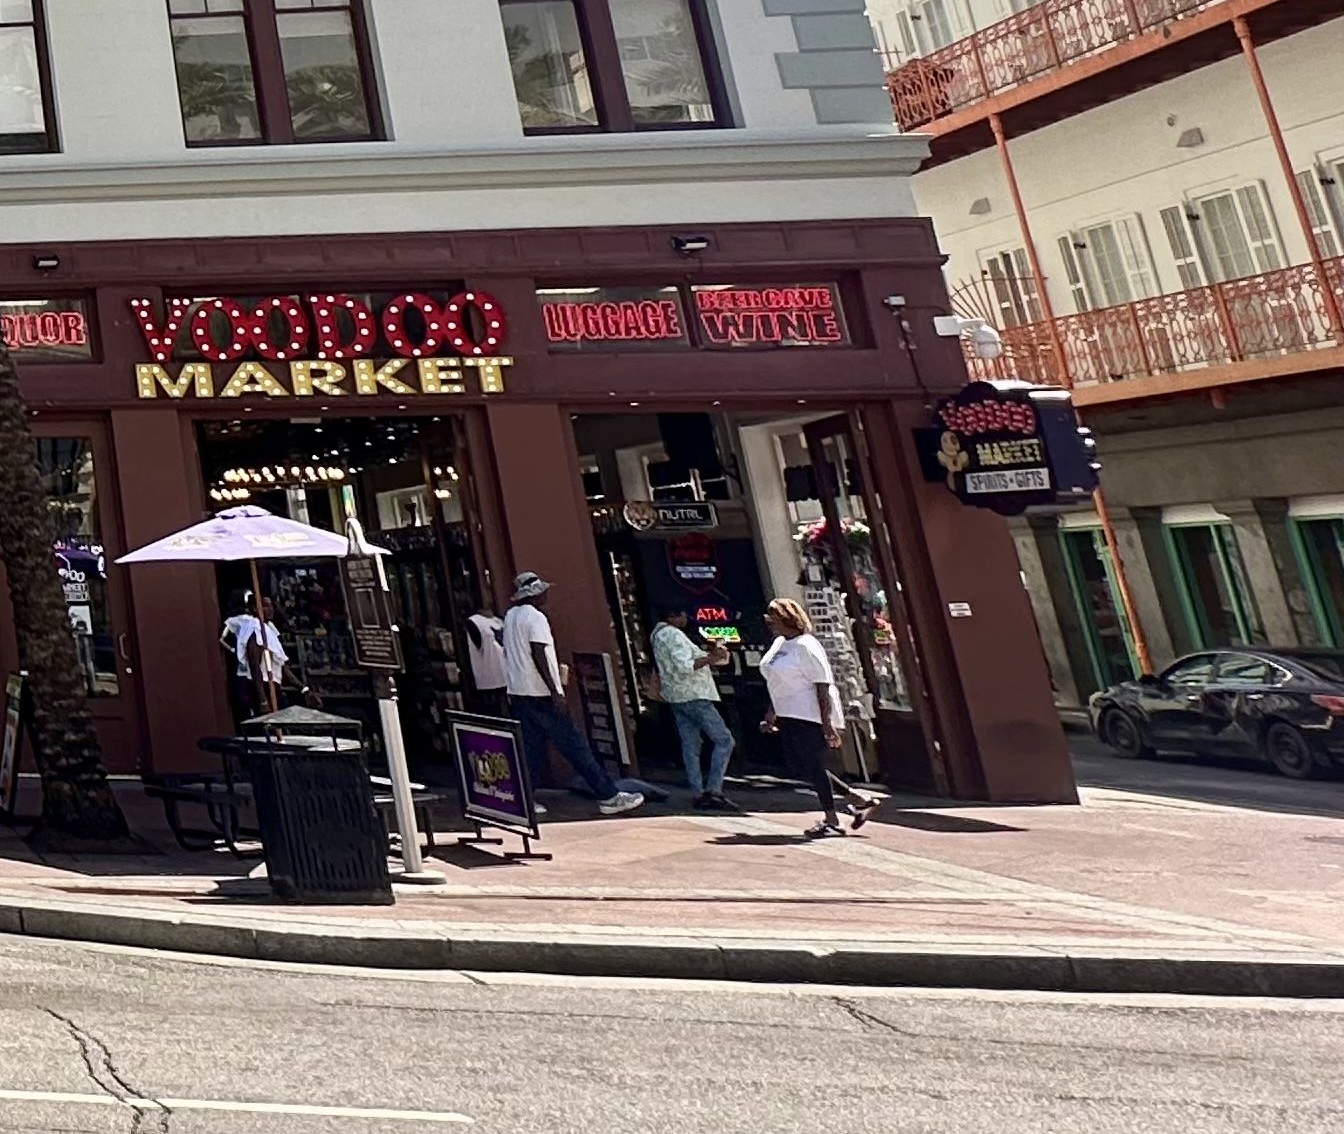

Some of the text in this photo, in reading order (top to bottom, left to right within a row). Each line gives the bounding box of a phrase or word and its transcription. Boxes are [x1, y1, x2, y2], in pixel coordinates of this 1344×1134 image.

[695, 288, 833, 310] BEER CAVE
[0, 311, 86, 350] QUOR
[131, 291, 507, 361] VOODOO
[542, 300, 682, 342] LUGGAGE
[699, 311, 842, 343] WINE
[134, 357, 513, 399] MARKET
[976, 438, 1042, 466] MARKET
[969, 470, 1045, 491] SPIRITS GIFTS
[696, 608, 728, 621] ATM
